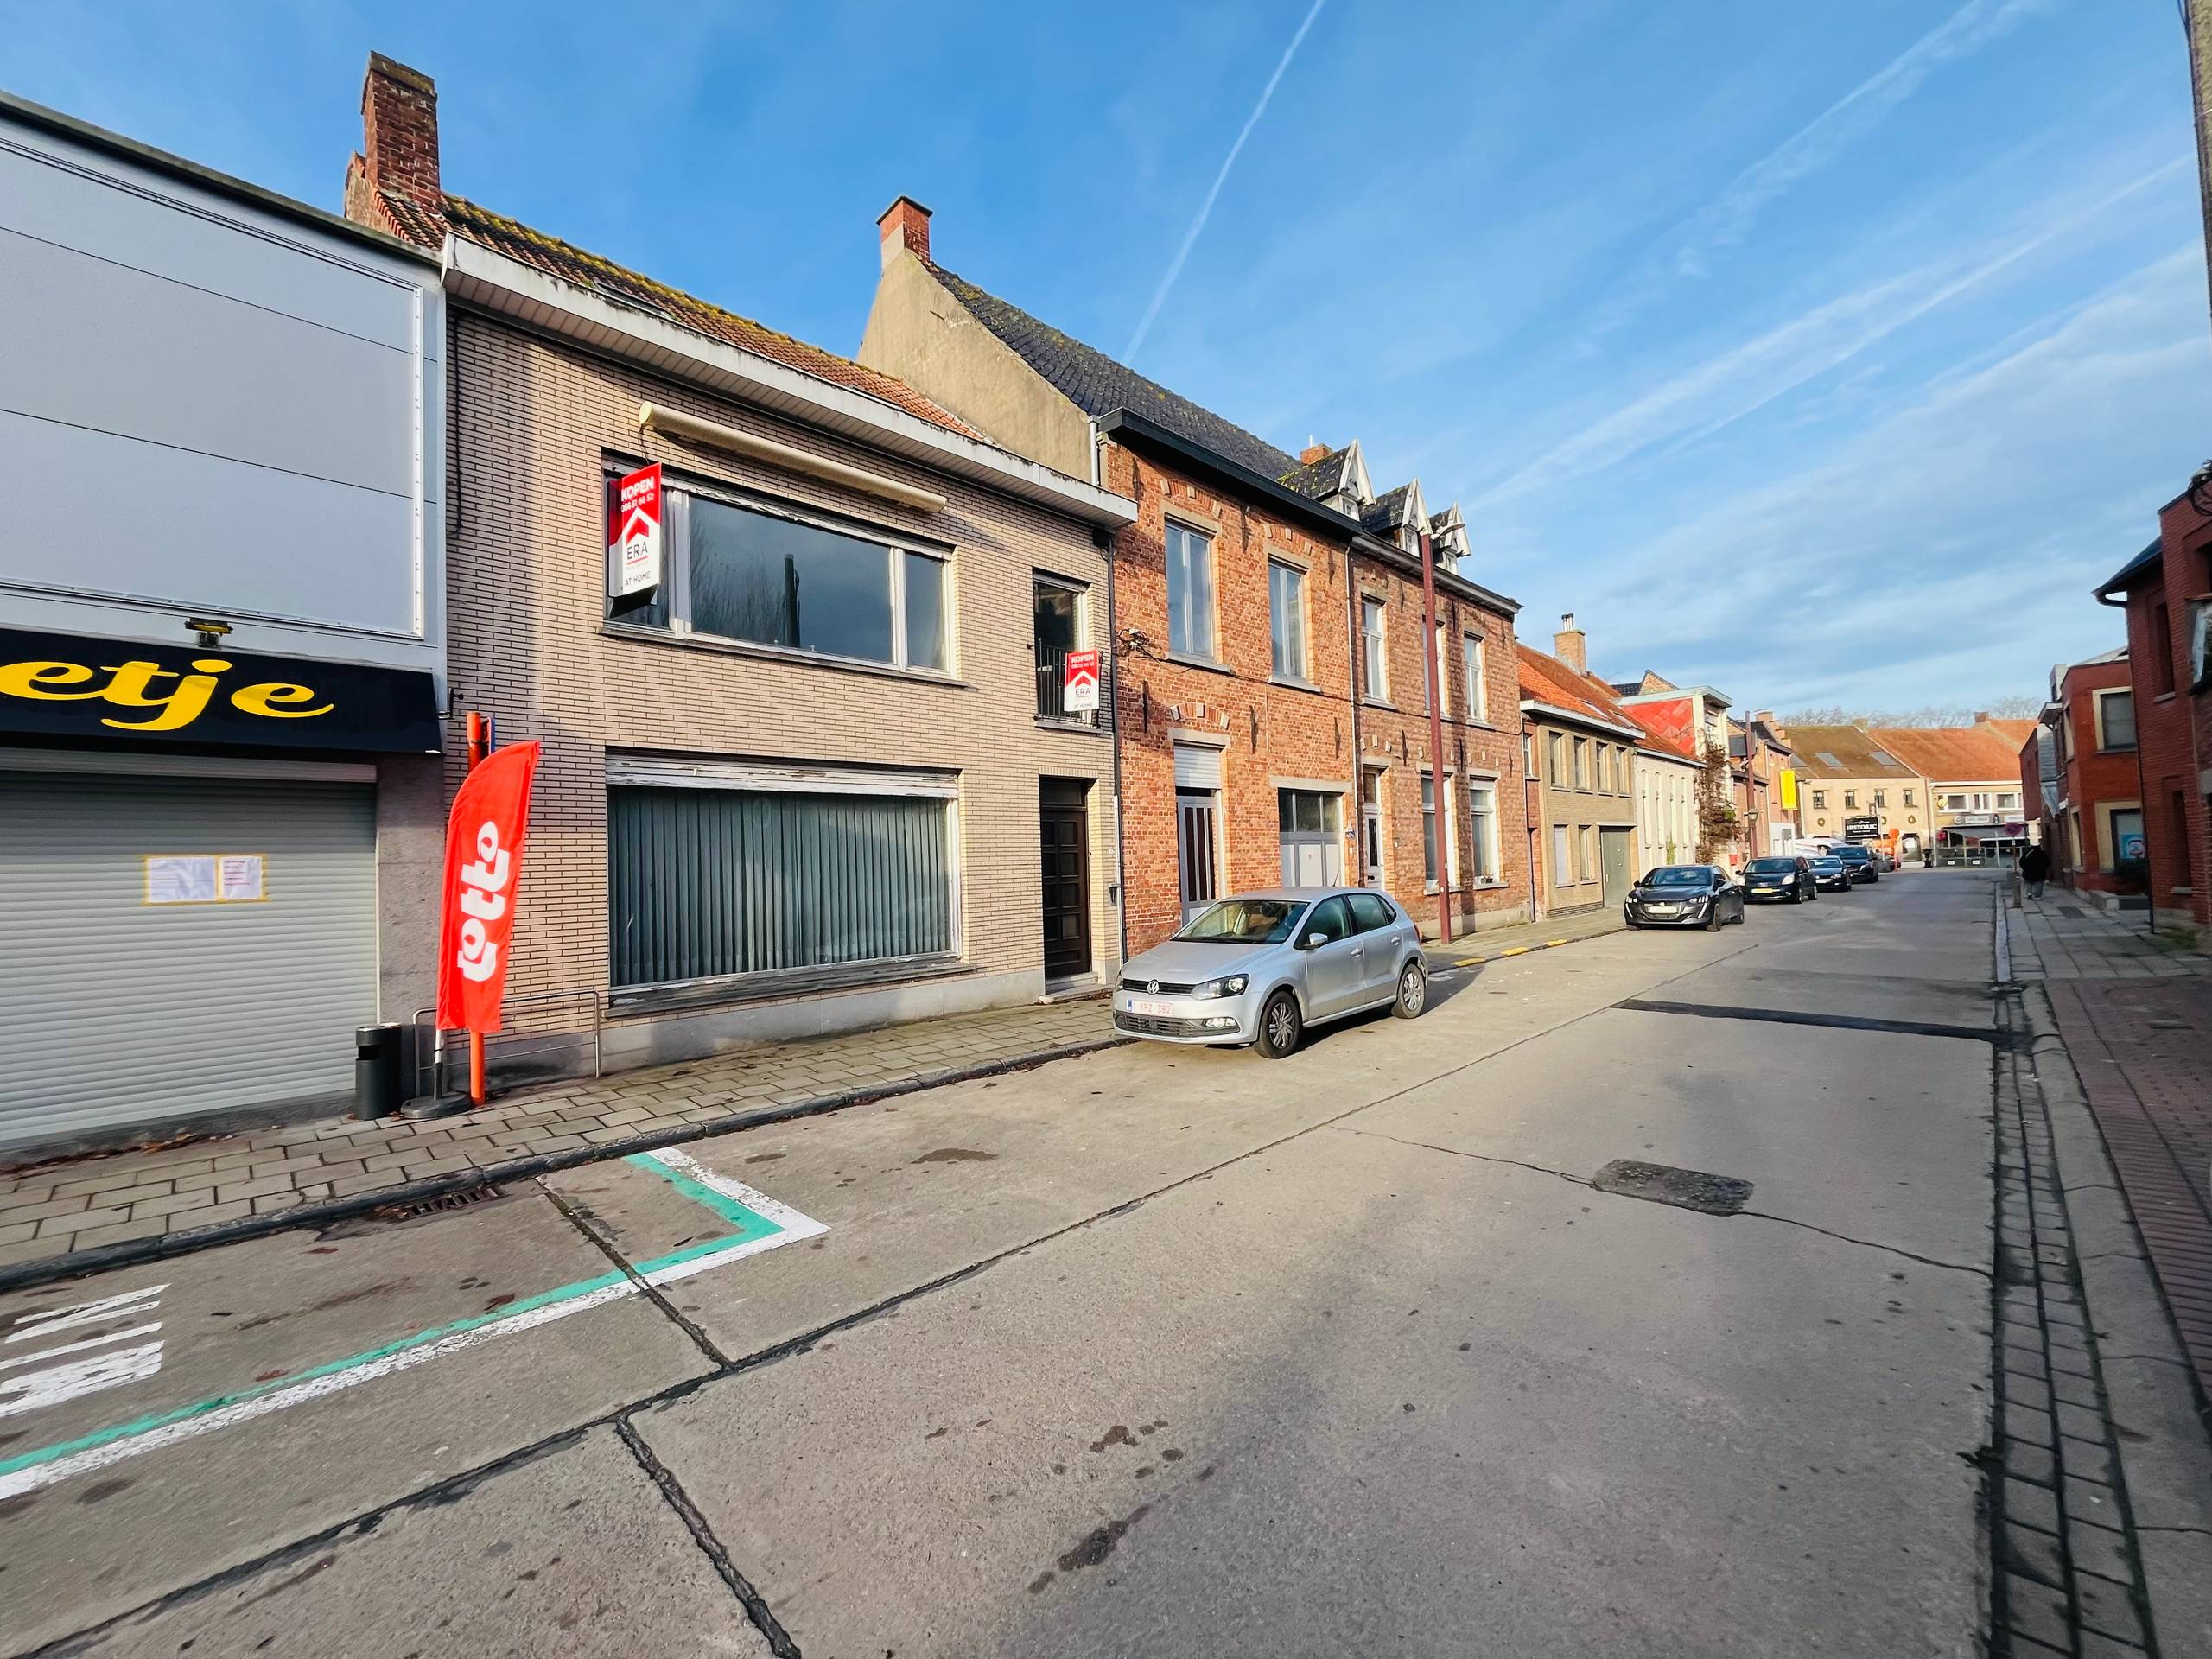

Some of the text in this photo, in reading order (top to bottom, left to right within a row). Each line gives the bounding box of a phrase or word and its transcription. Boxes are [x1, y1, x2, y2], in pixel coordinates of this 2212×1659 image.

[620, 476, 654, 501] KOPEN
[626, 541, 648, 560] ERA
[625, 570, 651, 586] AT HOME
[1071, 654, 1094, 663] KOPEN
